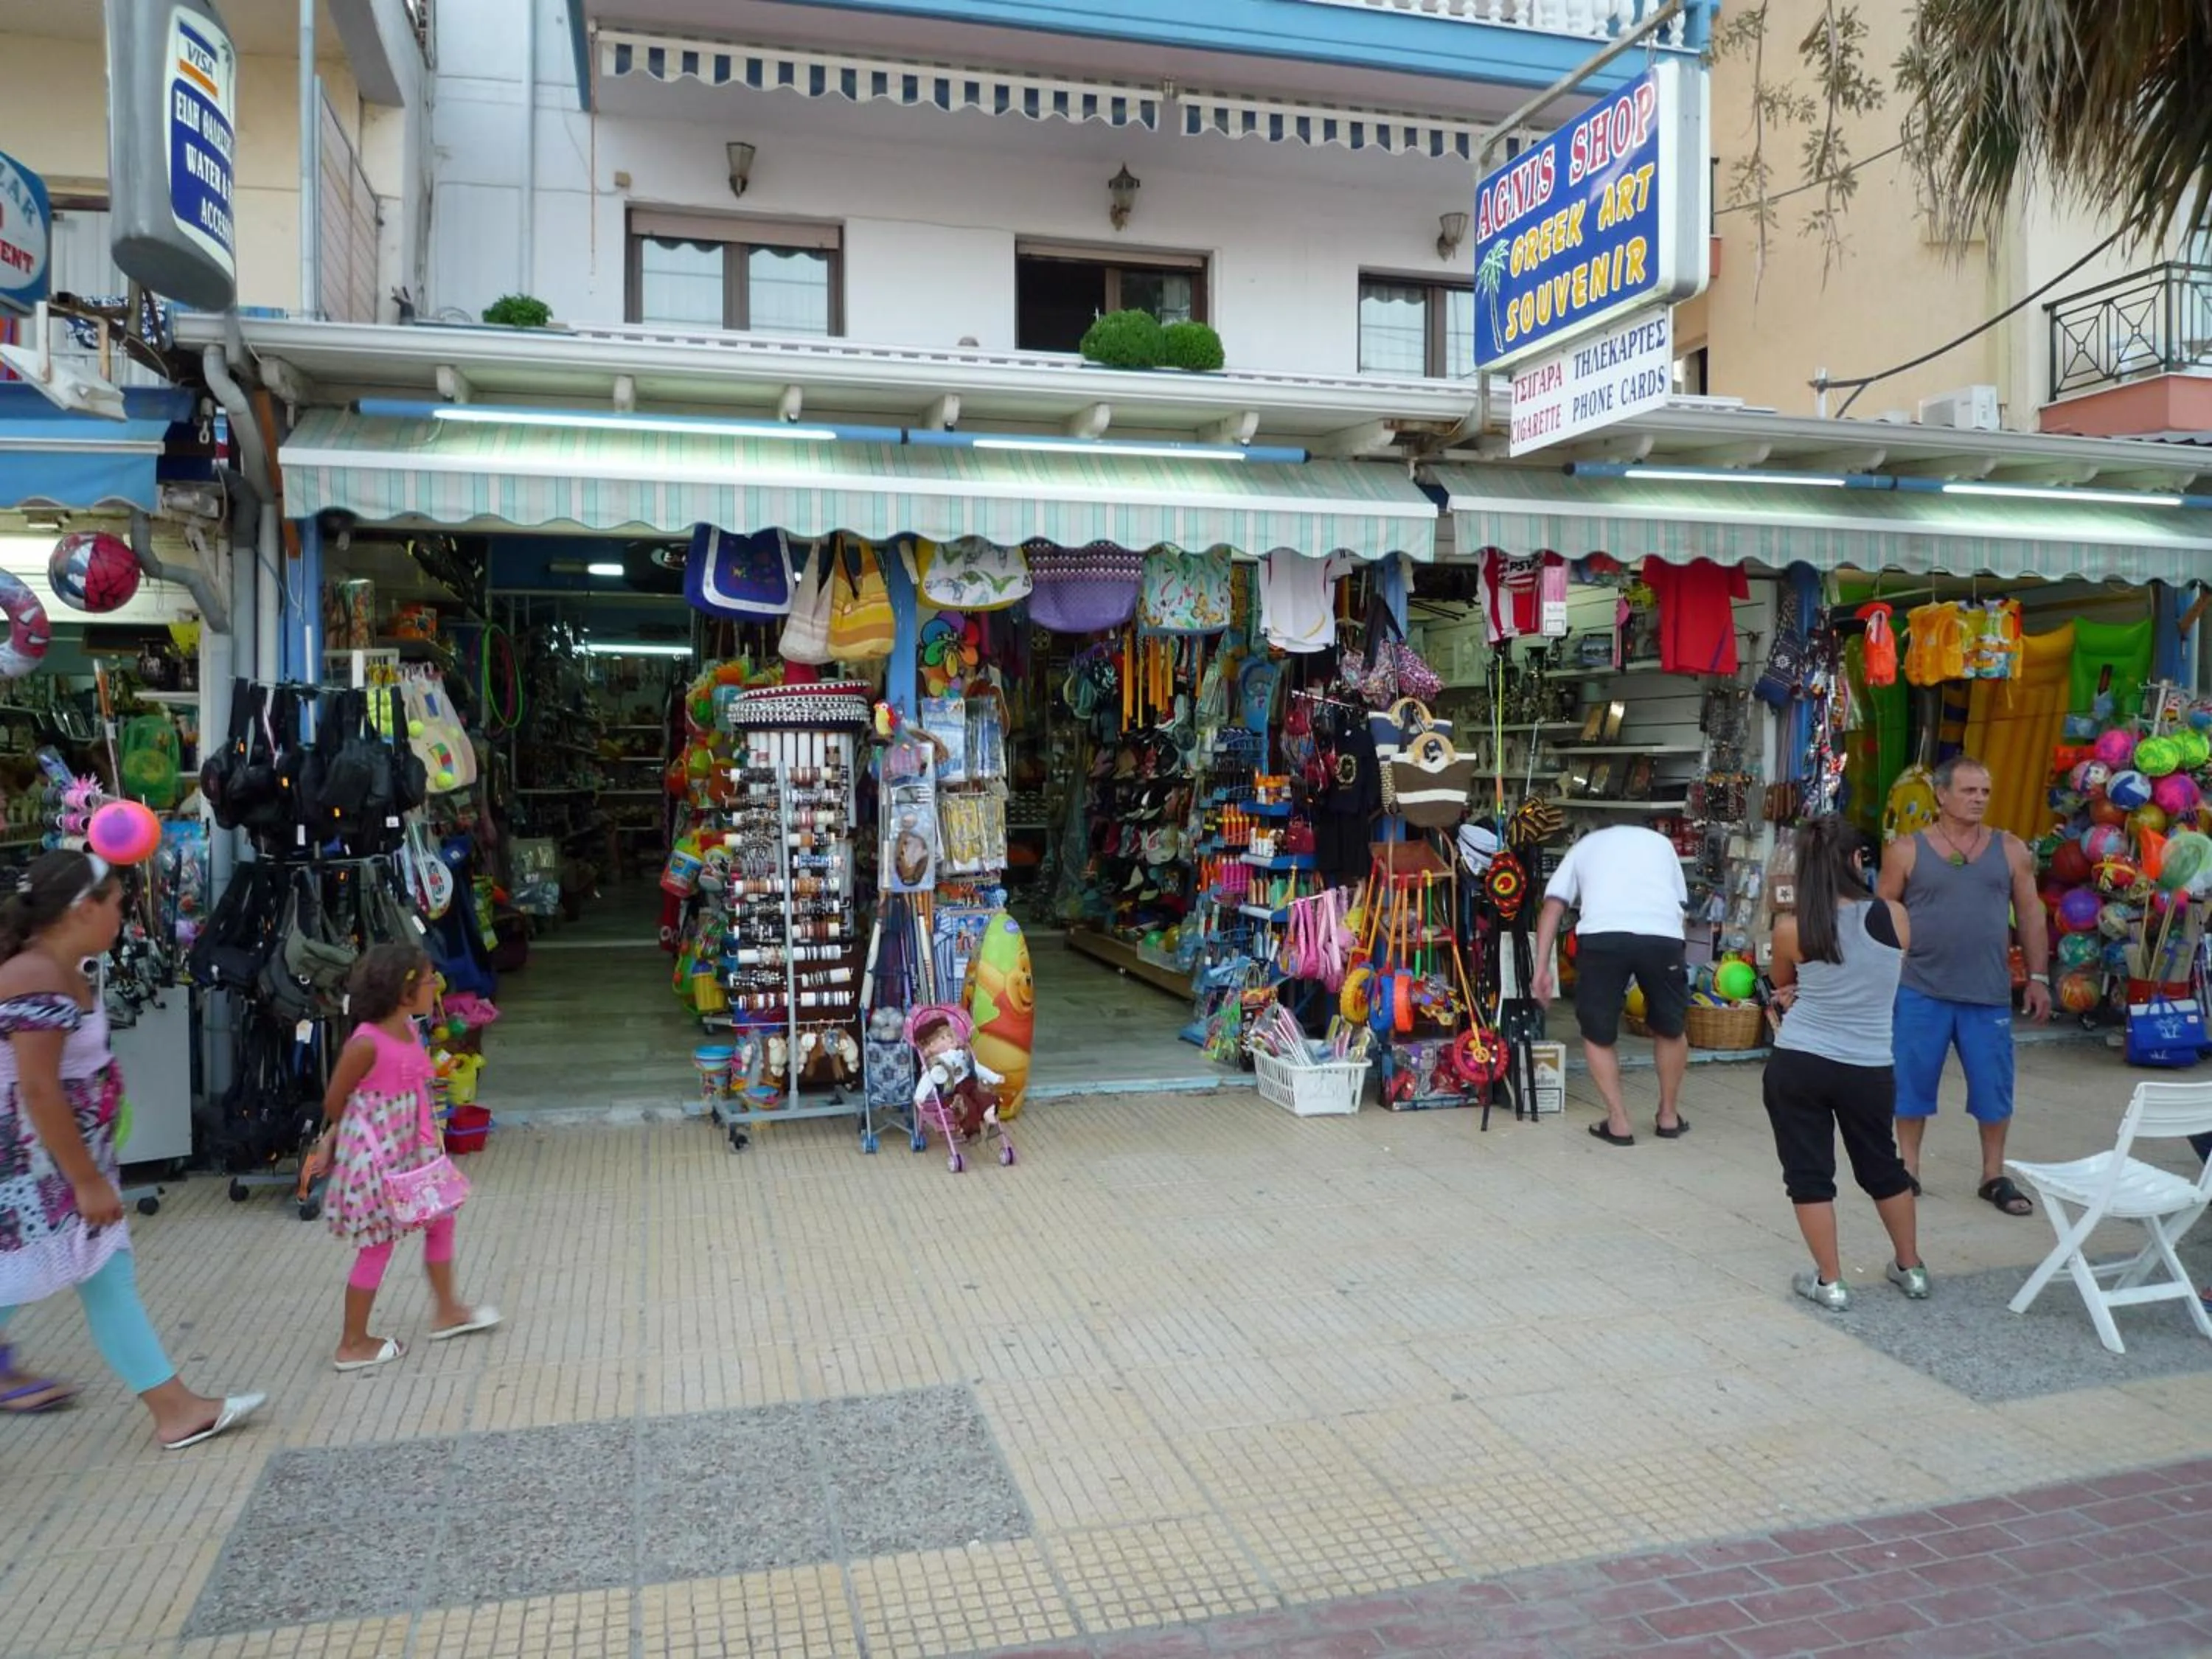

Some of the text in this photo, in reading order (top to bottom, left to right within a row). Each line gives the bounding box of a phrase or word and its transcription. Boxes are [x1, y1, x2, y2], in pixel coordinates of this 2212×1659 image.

[187, 40, 213, 79] VISA
[185, 142, 221, 195] WATER
[1477, 82, 1655, 244] AGNIS SHOP
[1509, 161, 1655, 278] GREEK ART
[1505, 236, 1646, 342] SOUVENIR
[1513, 318, 1666, 406] ΤΣΙΓΑΡΑ ΤΗΛΕΚΑΡΤΕΣ
[1511, 364, 1665, 445] CIGARETTE PHONE CARDS
[1509, 560, 1534, 572] PSV
